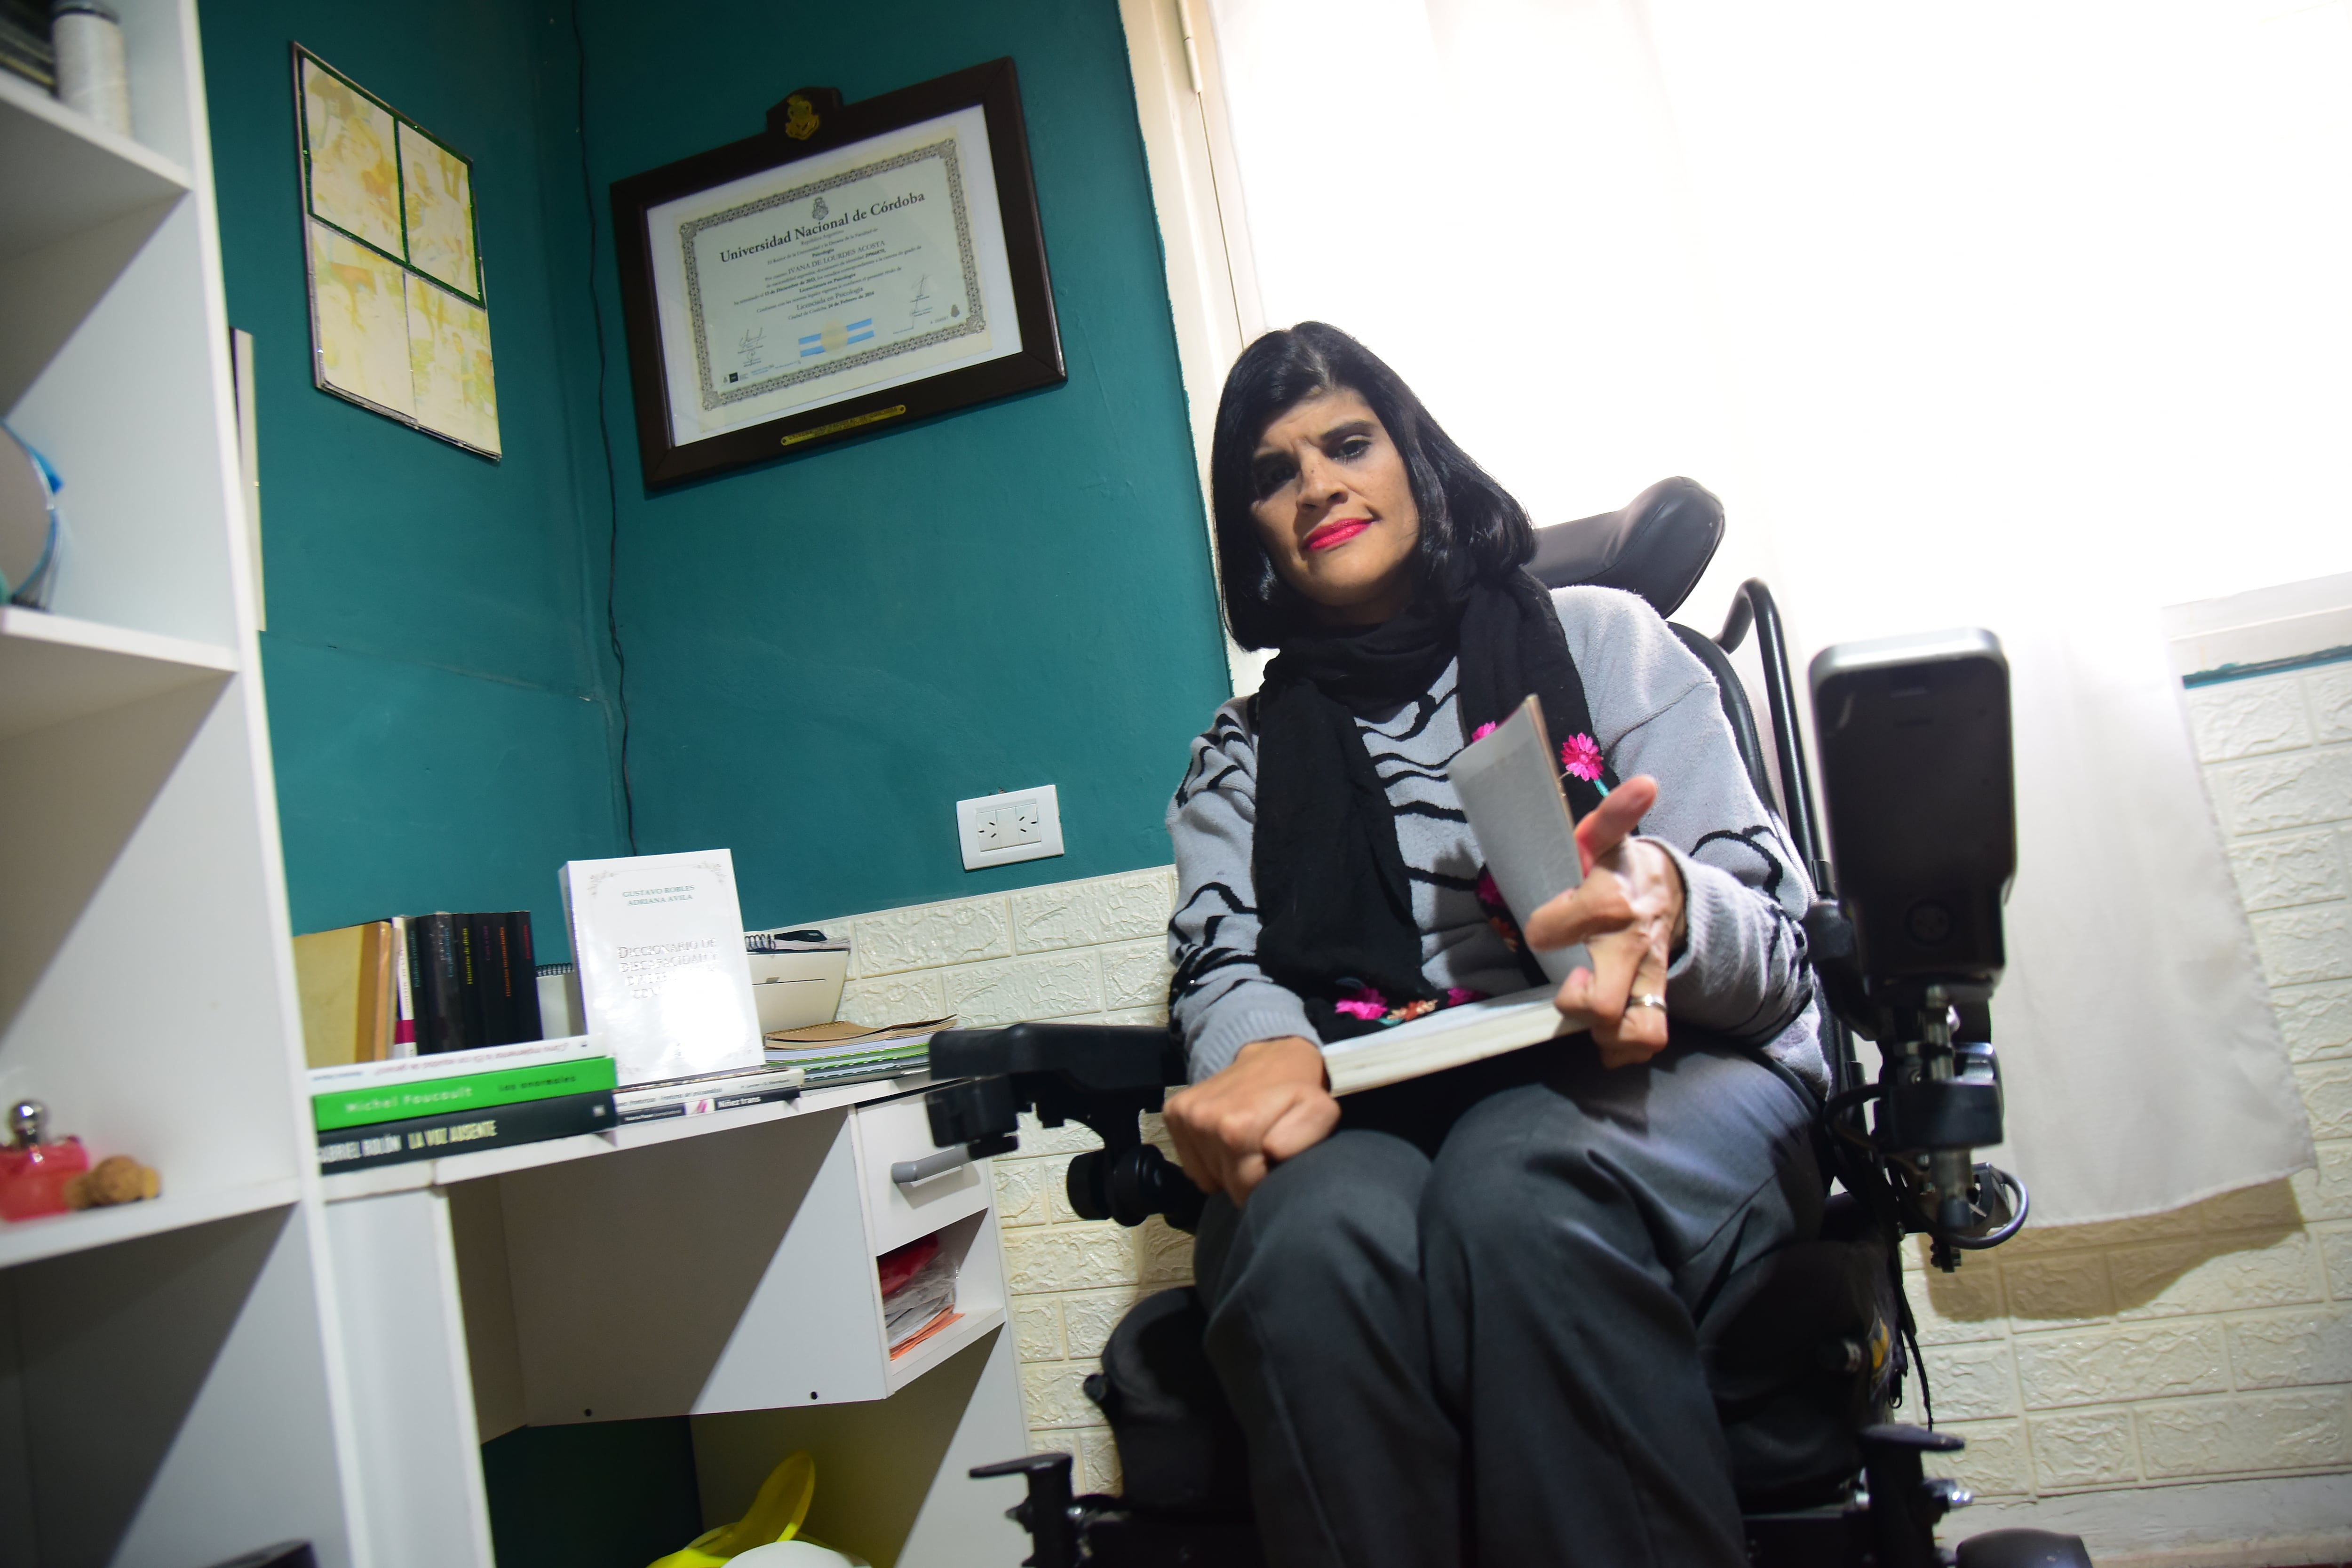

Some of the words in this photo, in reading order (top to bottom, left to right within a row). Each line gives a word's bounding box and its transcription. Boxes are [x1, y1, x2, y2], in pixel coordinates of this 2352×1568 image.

[720, 231, 792, 263] Universidad
[795, 213, 849, 240] Nacional
[853, 209, 867, 223] de
[870, 191, 925, 216] Córdoba
[788, 262, 810, 274] IVANA
[811, 258, 822, 268] DE
[823, 248, 856, 264] LOURDES
[857, 239, 885, 254] ACOSTA
[664, 885, 695, 893] ROBLES
[521, 1076, 576, 1089] anormales
[346, 1095, 398, 1112] Michel
[403, 1086, 473, 1105] Foucault
[717, 1099, 740, 1108] Niñez
[740, 1096, 762, 1105] trans
[407, 1131, 425, 1150] LA
[424, 1127, 448, 1146] VOZ
[449, 1119, 498, 1143] AUSENTE
